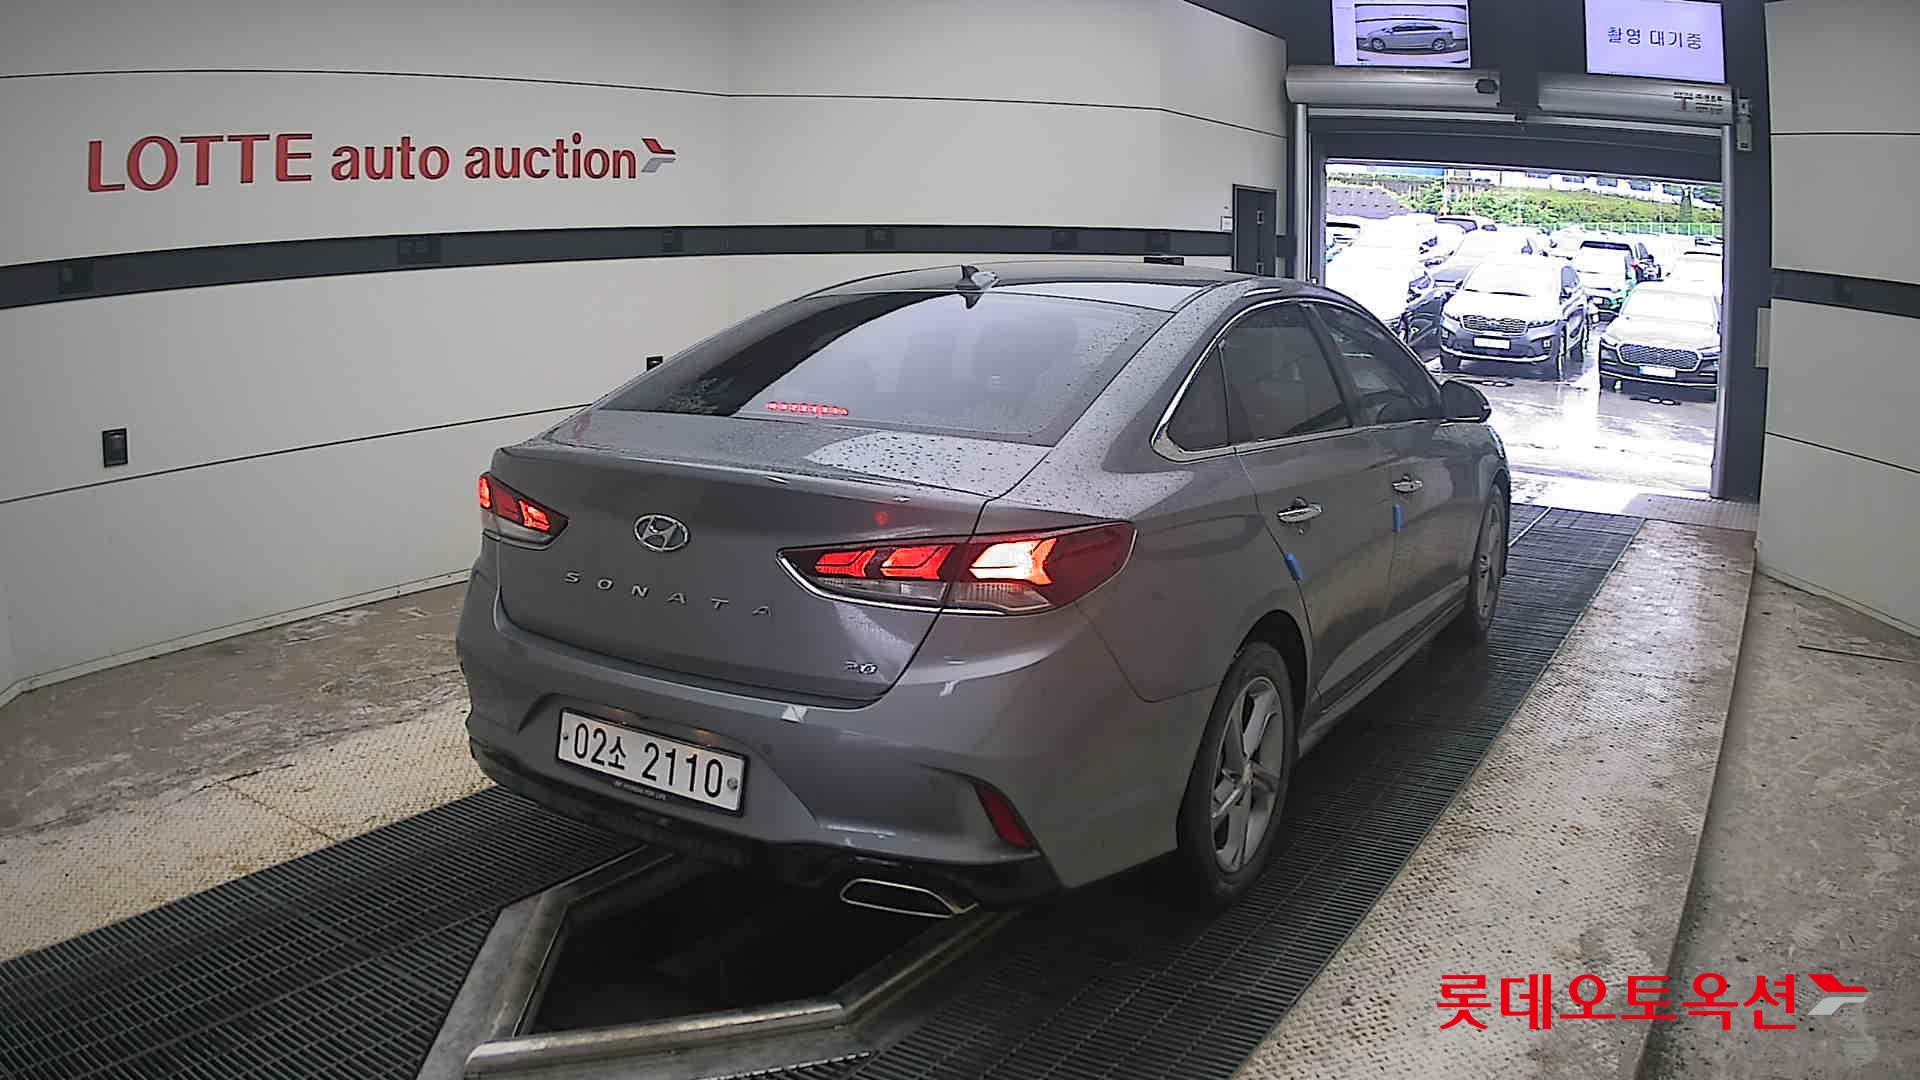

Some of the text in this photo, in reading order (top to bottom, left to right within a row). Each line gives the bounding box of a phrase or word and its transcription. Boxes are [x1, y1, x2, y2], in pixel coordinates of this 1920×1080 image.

[1649, 30, 1702, 49] 대기중
[87, 132, 637, 193] LOTTE auto auction
[564, 571, 773, 617] SONATA
[574, 723, 723, 798] 02소 2110
